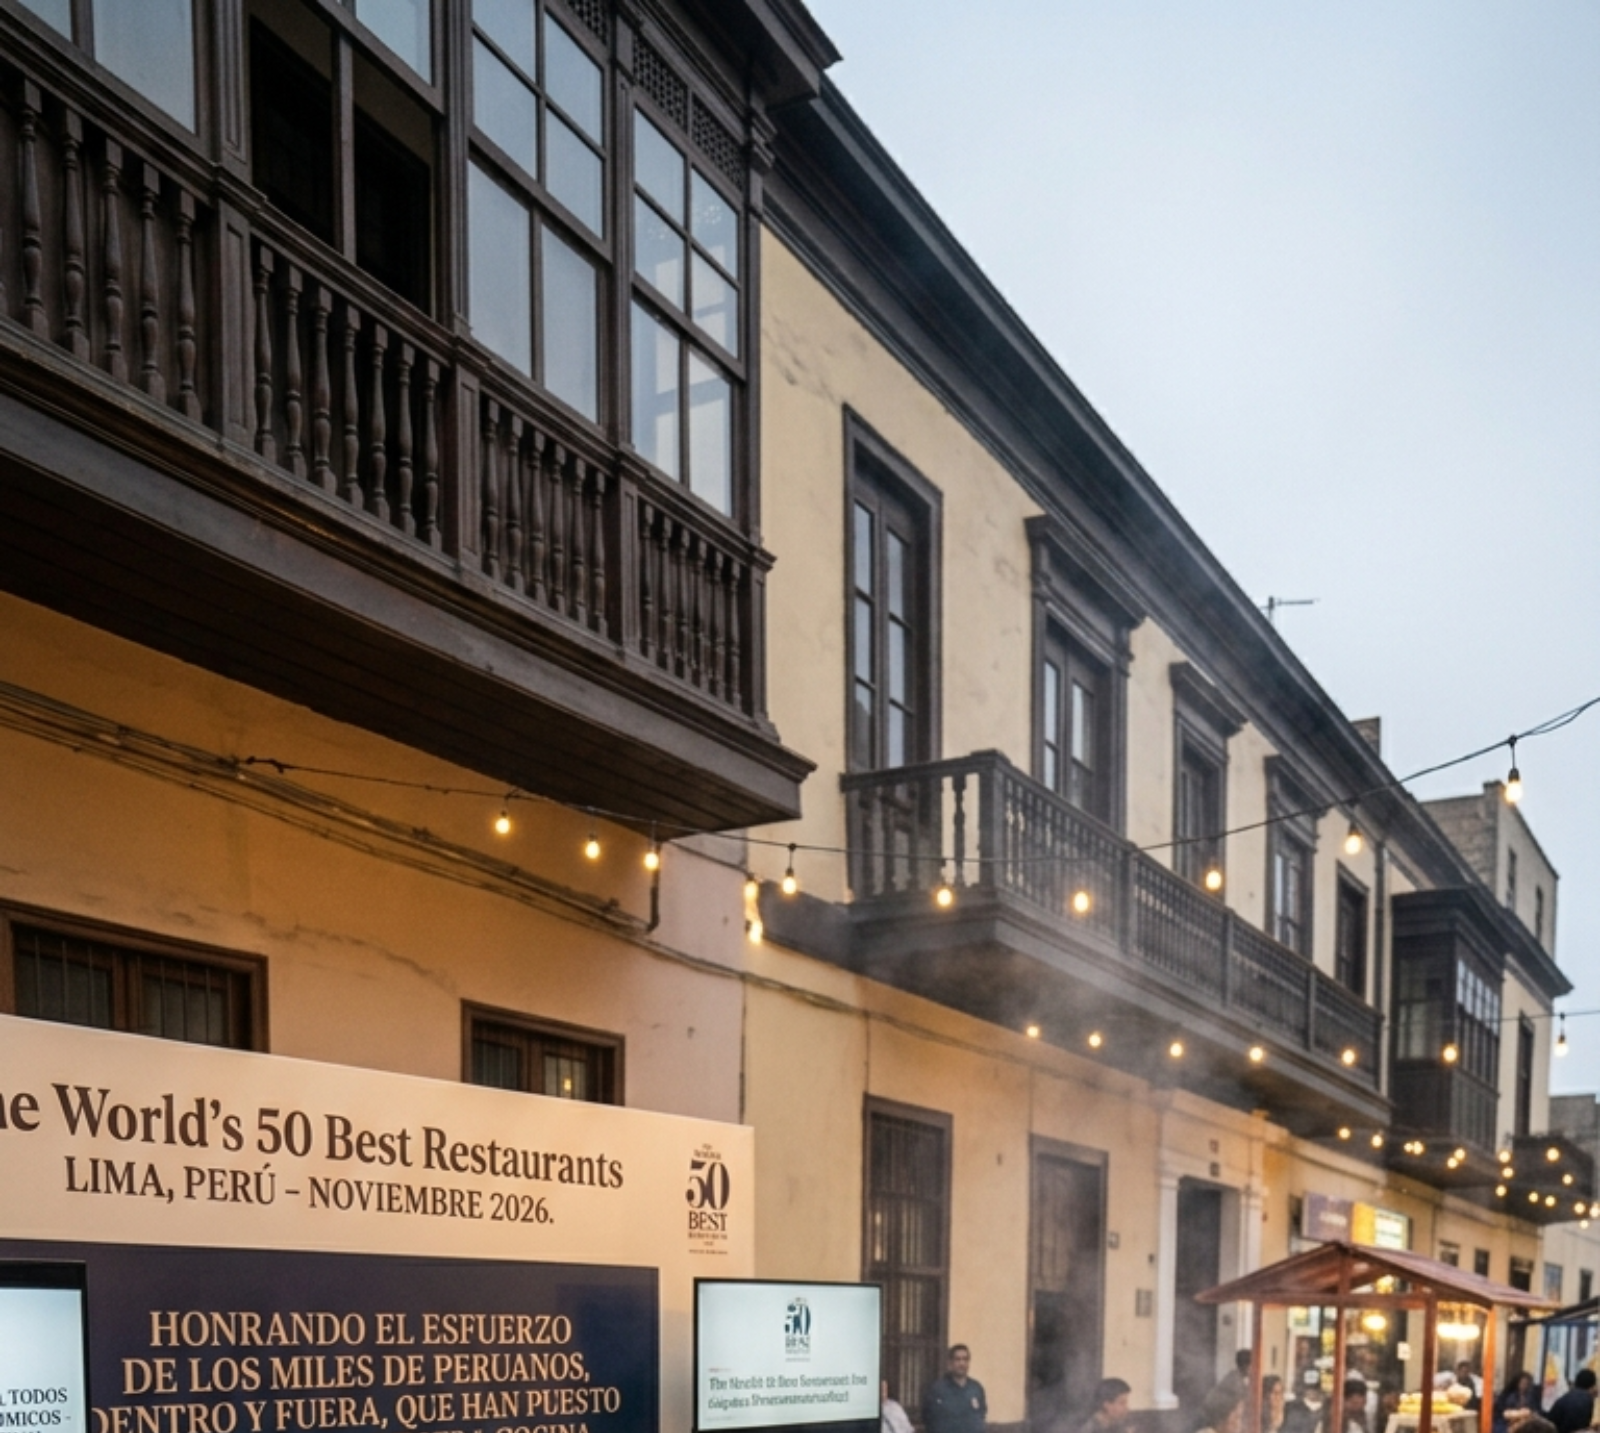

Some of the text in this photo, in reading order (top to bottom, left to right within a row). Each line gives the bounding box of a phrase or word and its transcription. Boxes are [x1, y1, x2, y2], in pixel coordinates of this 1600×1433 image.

[0, 1082, 624, 1189] e World's 50 Best Restaurants
[64, 1155, 175, 1203] LIMA,
[183, 1162, 276, 1204] PERÚ
[308, 1176, 483, 1219] NOVIEMBRE
[490, 1193, 555, 1224] 2026.
[685, 1158, 730, 1211] 50
[688, 1211, 728, 1231] BEST
[150, 1310, 572, 1346] HONRANDO EL ESFUERZO
[122, 1351, 590, 1395] DE LOS MILES DE PERUANOS,
[8, 1387, 68, 1406] TODOS
[243, 1400, 267, 1432] Y
[274, 1395, 388, 1430] FUERA,
[395, 1393, 455, 1430] QUE
[462, 1390, 520, 1421] HAN
[526, 1386, 621, 1418] PUESTO
